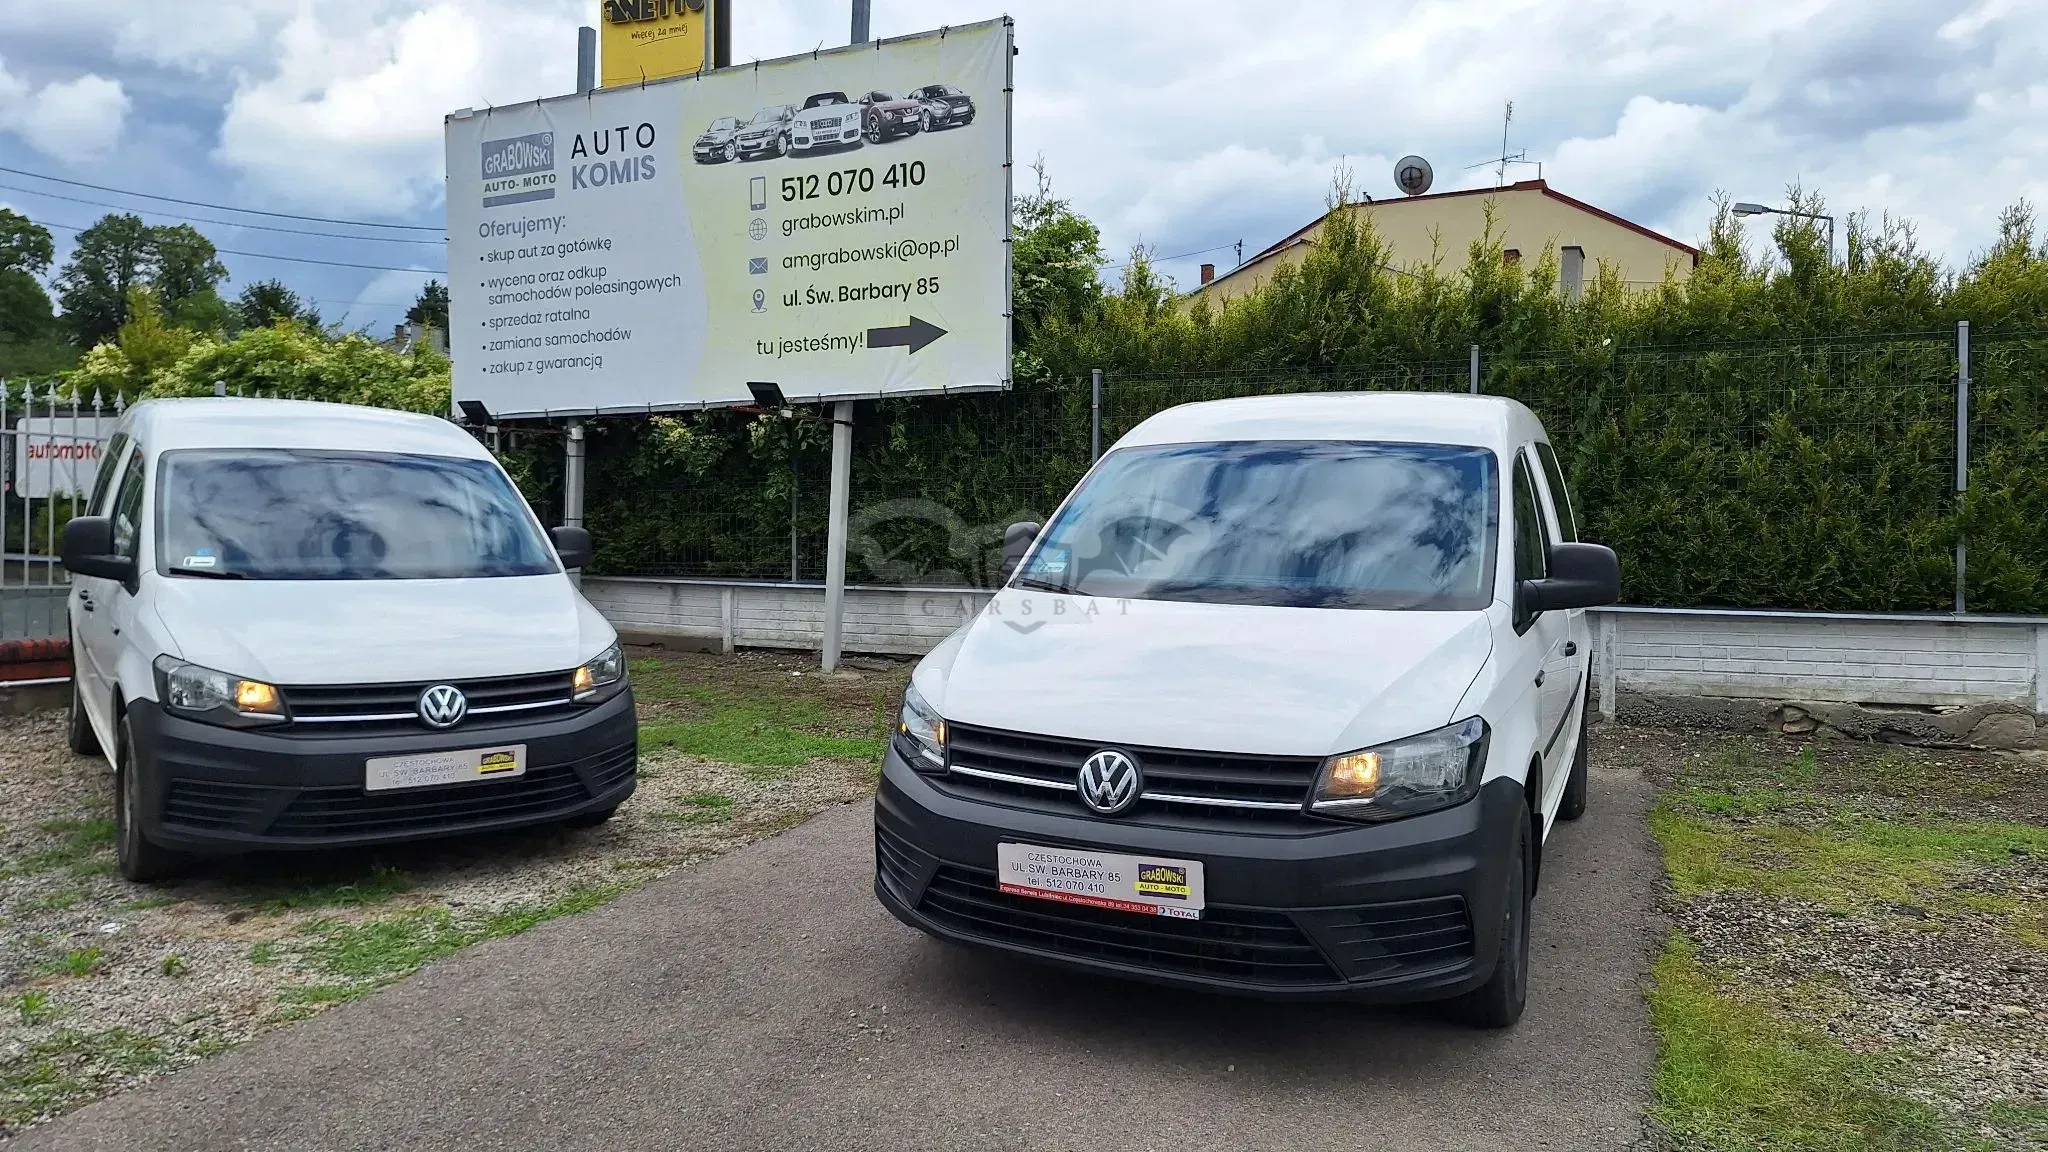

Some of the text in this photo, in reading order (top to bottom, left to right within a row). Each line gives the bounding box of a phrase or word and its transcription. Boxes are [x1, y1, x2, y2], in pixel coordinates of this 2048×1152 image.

[571, 122, 656, 160] AUTO
[485, 140, 551, 174] GRABOWSKI
[523, 173, 557, 188] MOTO
[572, 154, 656, 190] KOMIS
[782, 160, 926, 202] 512 070 410
[479, 215, 566, 239] Oferujemy:
[782, 203, 905, 236] grabowskim.pl
[487, 237, 612, 265] skup aut za gotówkę
[782, 235, 960, 271] amgrabowski@op.pl
[488, 265, 607, 291] wycena oraz odkup
[488, 273, 682, 305] samochodów poleasingowych
[783, 276, 940, 307] ul. Św. Barbary 85
[489, 308, 590, 331] sprzedaż ratalna
[489, 328, 632, 352] zamiana samochodów
[756, 332, 864, 359] tu jesteśmy!
[489, 353, 603, 376] zakup z gwarancją
[1028, 877, 1105, 893] tel. 512 070 410
[1051, 866, 1105, 881] BARBARY
[1107, 872, 1121, 883] 85
[1139, 883, 1160, 891] AUTO
[1140, 867, 1184, 884] GRABOWSKI
[1168, 907, 1199, 919] TOTAL
